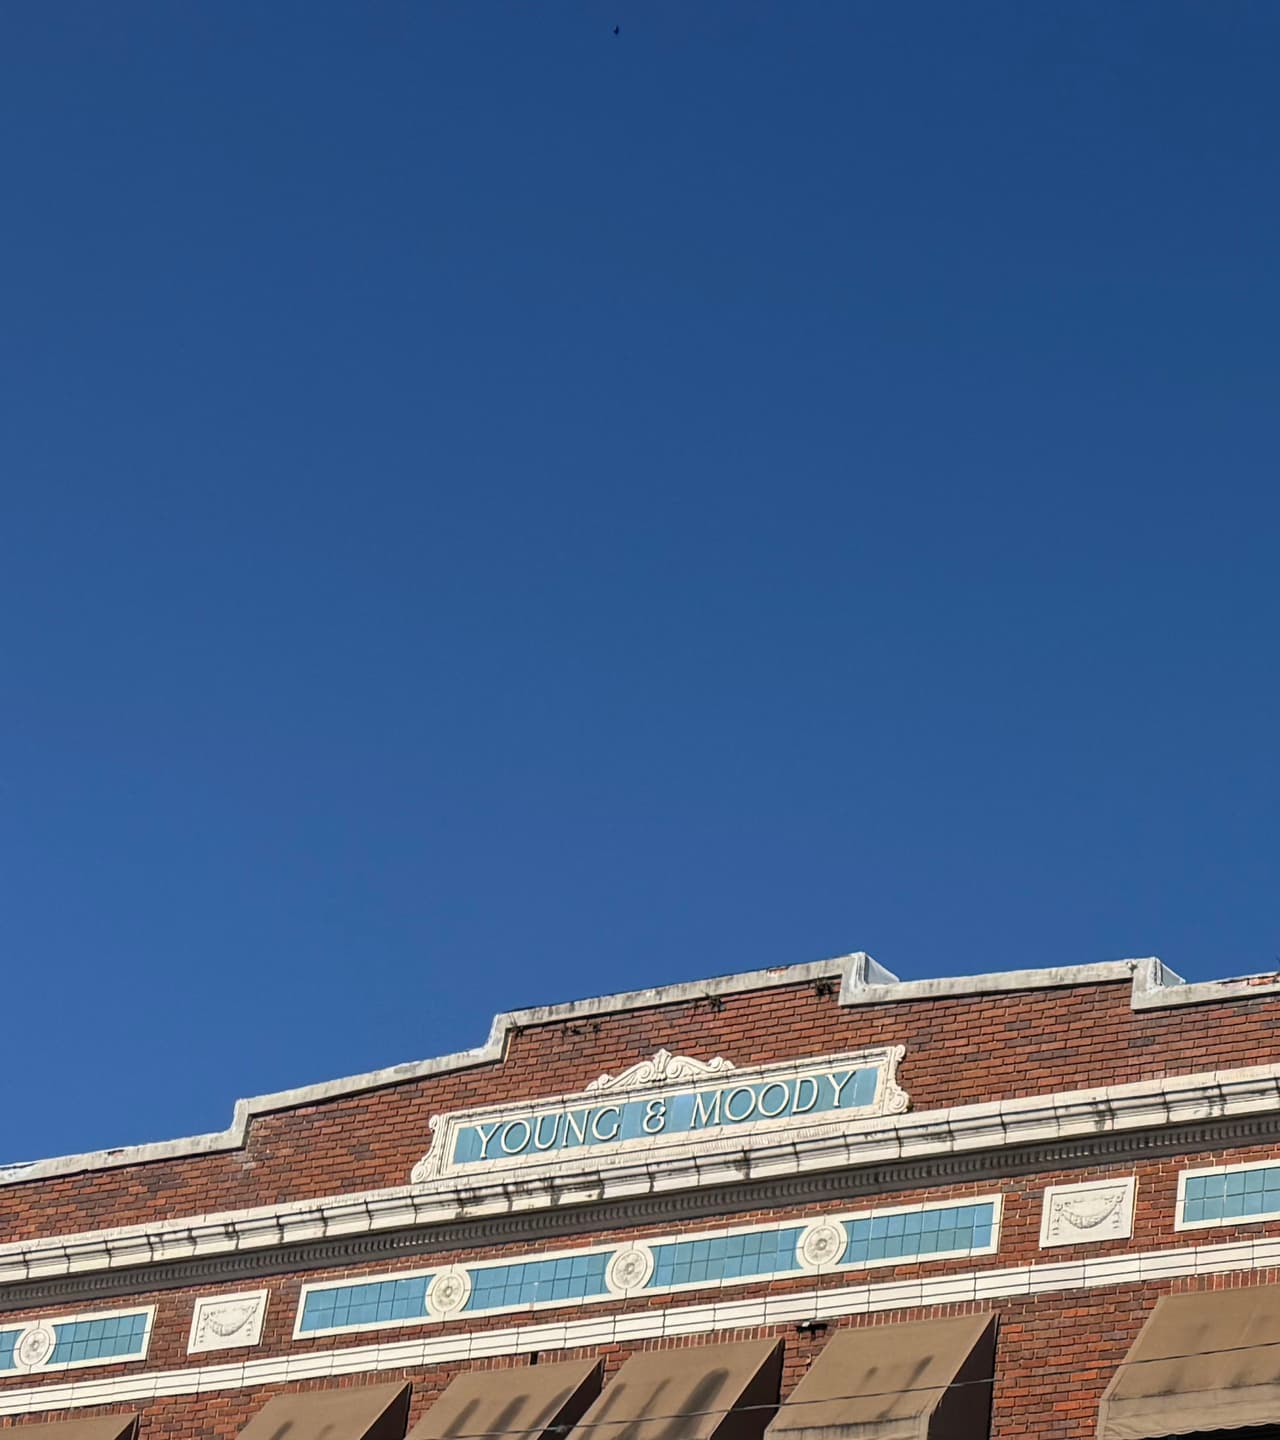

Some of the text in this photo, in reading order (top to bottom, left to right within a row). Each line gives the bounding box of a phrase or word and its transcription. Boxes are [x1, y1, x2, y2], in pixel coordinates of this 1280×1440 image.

[474, 1070, 857, 1160] YOUNG & MOODY
